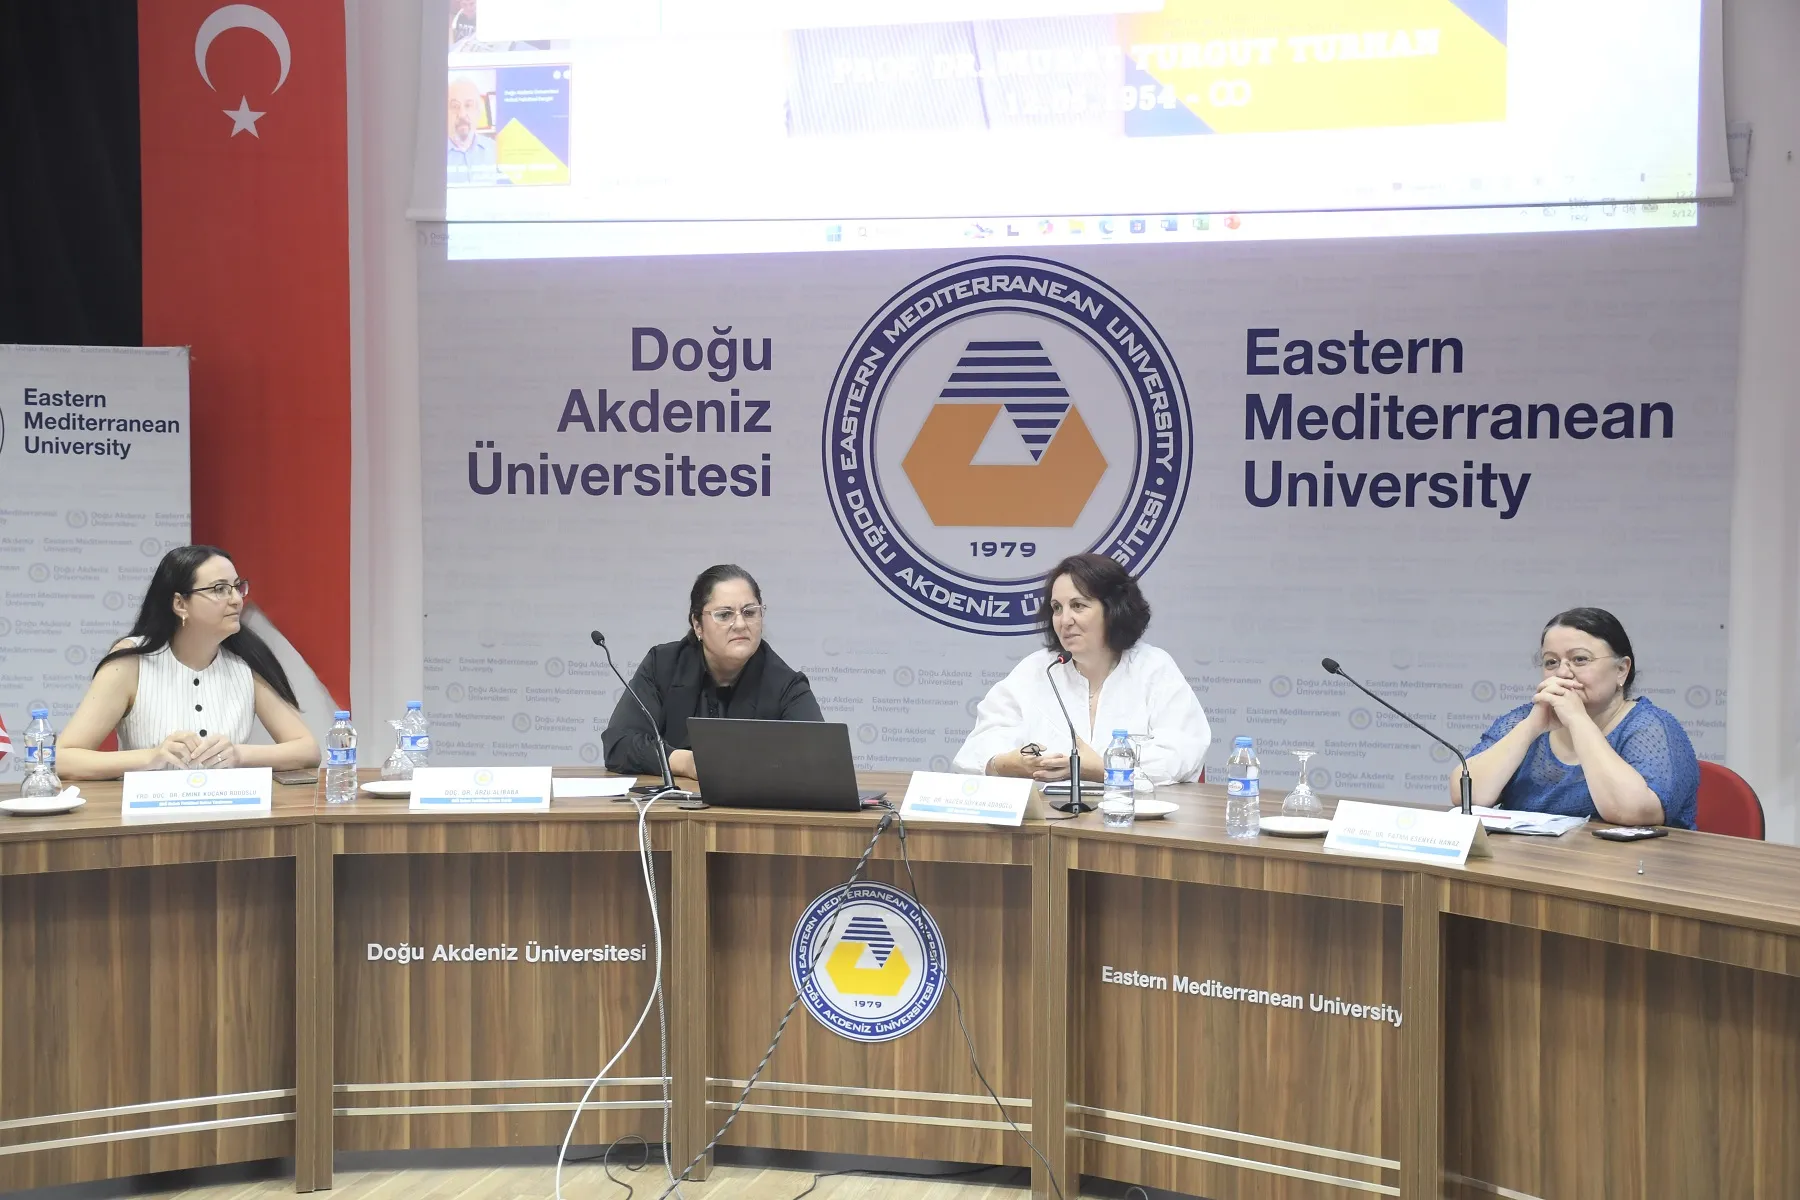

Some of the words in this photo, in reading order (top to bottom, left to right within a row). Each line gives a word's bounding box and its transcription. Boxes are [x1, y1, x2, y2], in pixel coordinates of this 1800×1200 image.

[998, 45, 1121, 76] MURAT
[1131, 37, 1278, 71] TURGUT
[1289, 29, 1440, 64] TURHAN
[632, 325, 772, 382] Doğu
[840, 345, 886, 472] EASTERN
[882, 274, 1105, 344] MEDITERRANEAN
[1105, 317, 1175, 473] UNIVERSITY
[1246, 328, 1464, 375] Eastern
[24, 388, 107, 408] Eastern
[556, 388, 772, 433] Akdeniz
[1244, 392, 1674, 440] Mediterranean
[24, 411, 180, 434] Mediterranean
[24, 436, 131, 460] University
[468, 440, 771, 497] Üniversitesi
[1244, 460, 1532, 519] University
[844, 488, 897, 565] DOĞU
[894, 566, 1011, 618] AKDENİZ
[969, 541, 1037, 558] 1979
[367, 942, 425, 965] Doğu
[432, 942, 518, 962] Akdeniz
[525, 940, 647, 963] Üniversitesi
[853, 1000, 882, 1009] 1979
[1101, 964, 1168, 991] Eastern
[1172, 974, 1304, 1011] Mediterranean
[1309, 992, 1404, 1028] University
